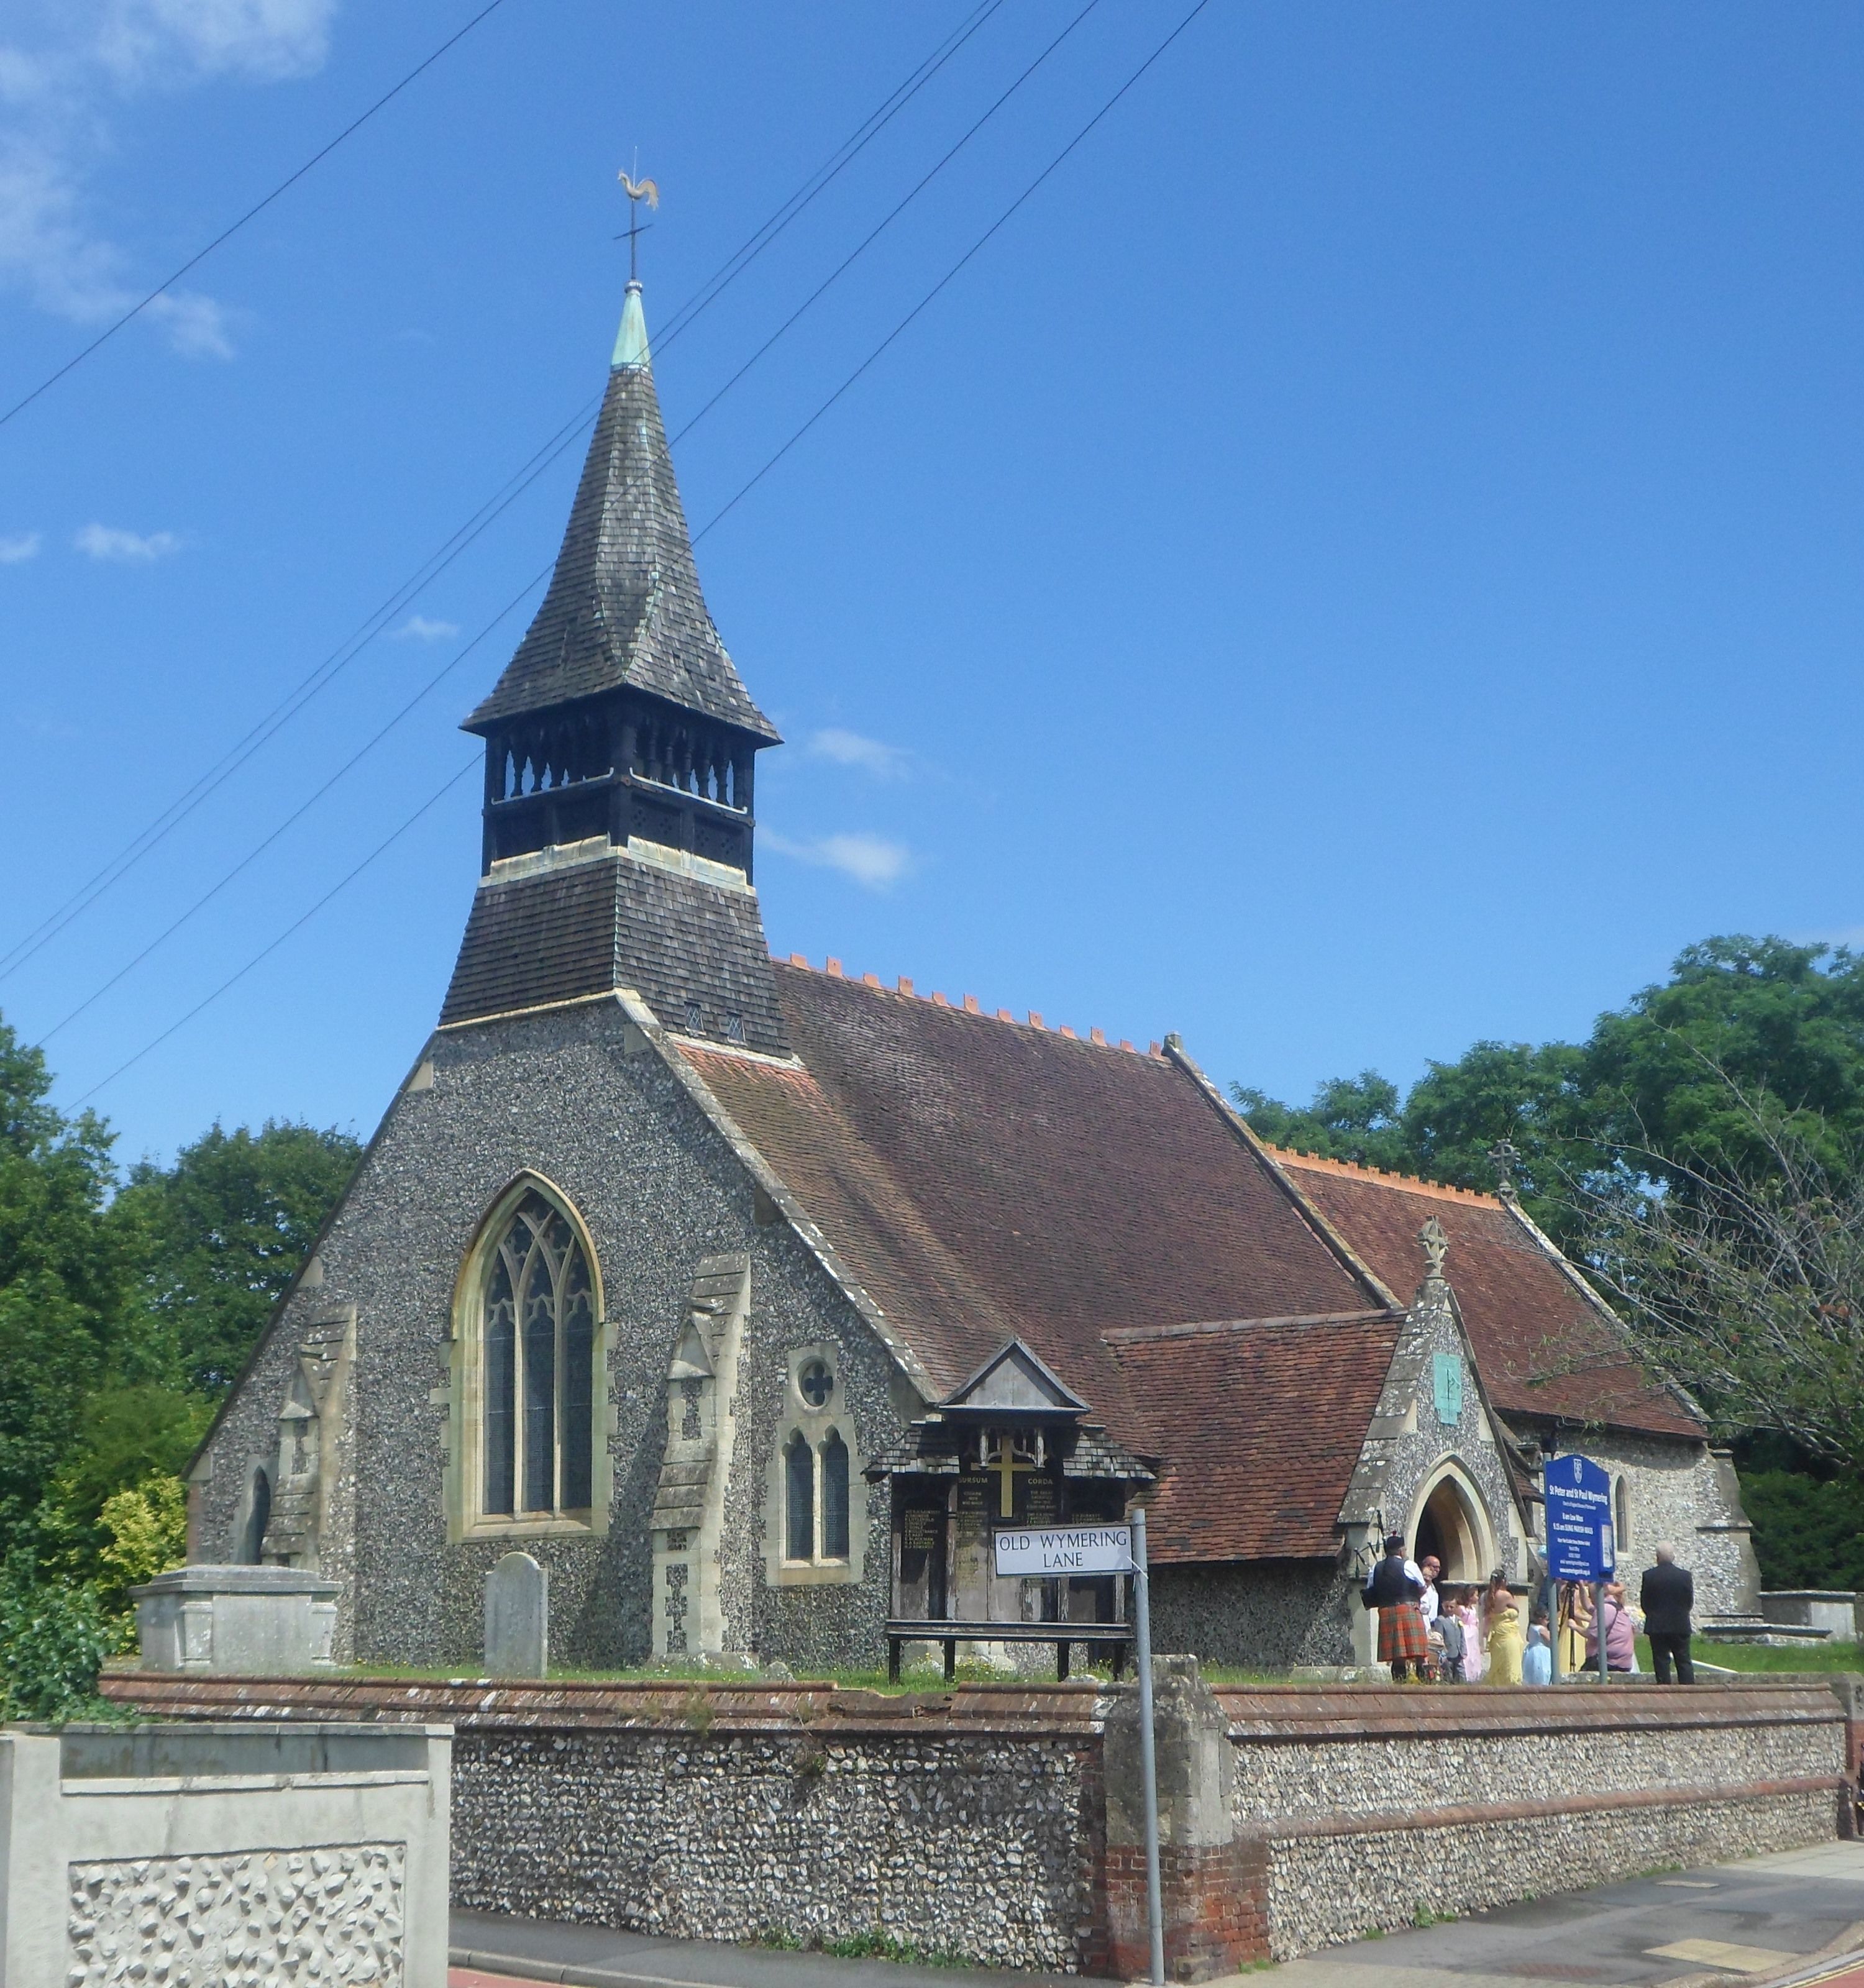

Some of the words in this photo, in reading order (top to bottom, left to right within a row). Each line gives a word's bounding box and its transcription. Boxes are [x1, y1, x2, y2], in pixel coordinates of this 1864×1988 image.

[1549, 1485, 1555, 1495] St
[1555, 1485, 1565, 1497] Peter
[1574, 1489, 1578, 1498] St
[1578, 1489, 1588, 1500] Paul
[1588, 1490, 1608, 1505] Wymering
[999, 1536, 1030, 1551] OLD
[1040, 1531, 1127, 1549] WYMERING
[1044, 1552, 1084, 1568] LANE
